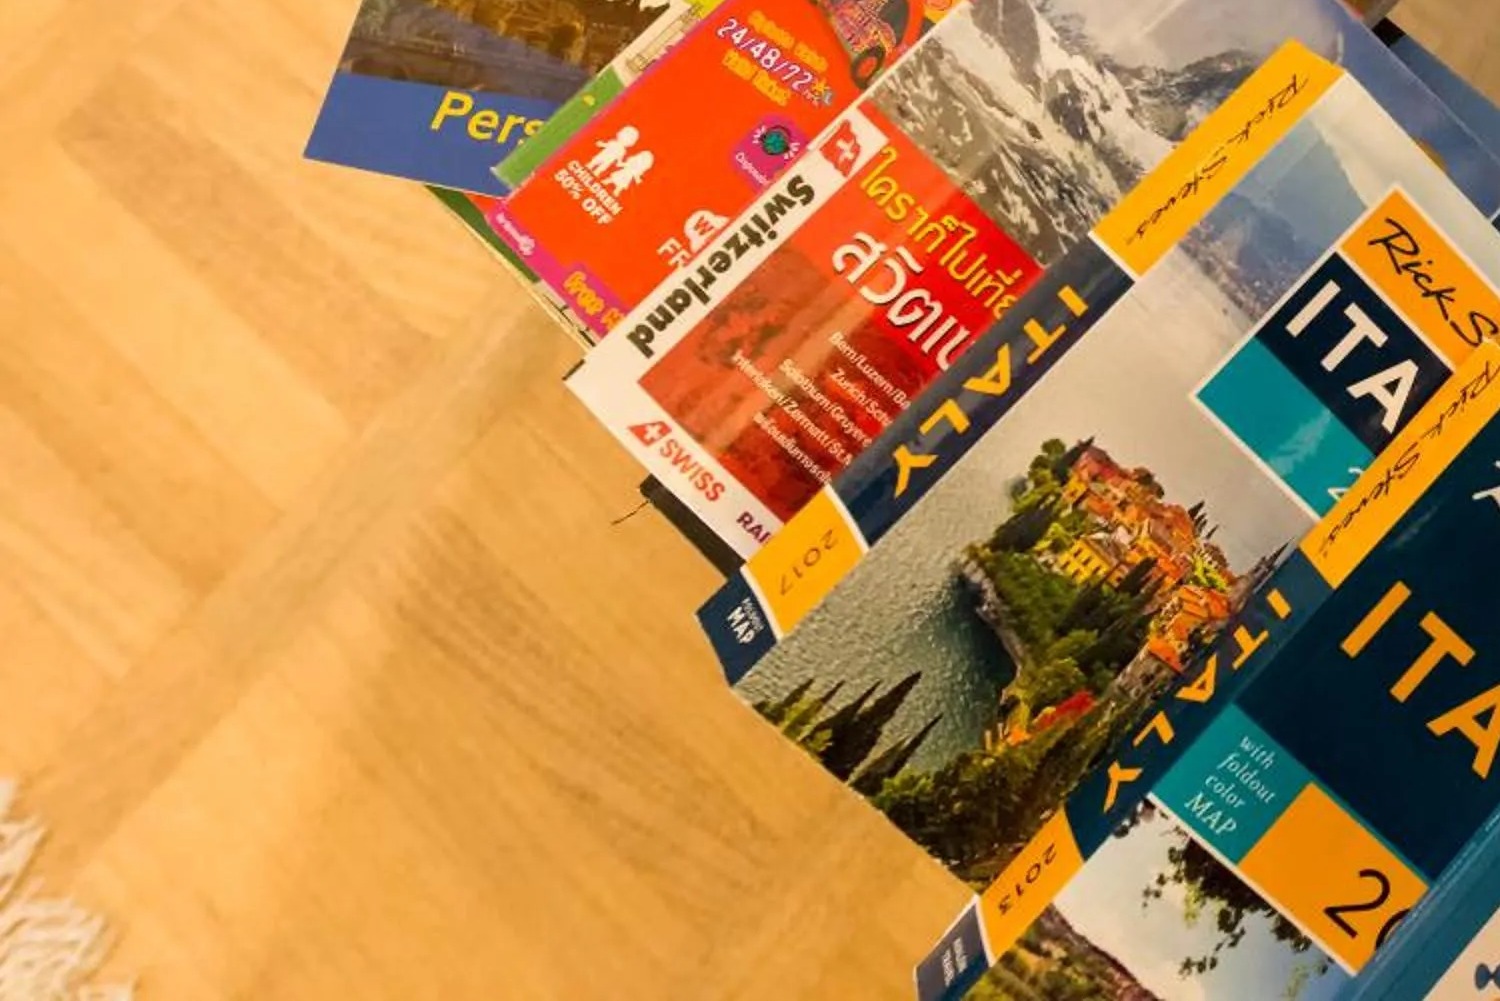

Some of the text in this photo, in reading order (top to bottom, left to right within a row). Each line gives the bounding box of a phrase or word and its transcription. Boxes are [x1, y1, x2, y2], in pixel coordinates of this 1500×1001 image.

[553, 168, 614, 225] 50% OFF
[566, 159, 624, 216] CHILDREN
[626, 174, 816, 359] Switzerland
[1367, 216, 1457, 322] Rick
[1284, 278, 1421, 436] ITA
[892, 284, 1091, 499] ITALY
[659, 436, 726, 503] SWISS
[778, 528, 840, 597] 2017
[726, 605, 757, 646] MAP
[1104, 589, 1294, 814] ITALY
[1215, 751, 1280, 806] foldout
[1239, 736, 1275, 771] with
[1183, 792, 1239, 838] MAP
[1203, 774, 1248, 811] color
